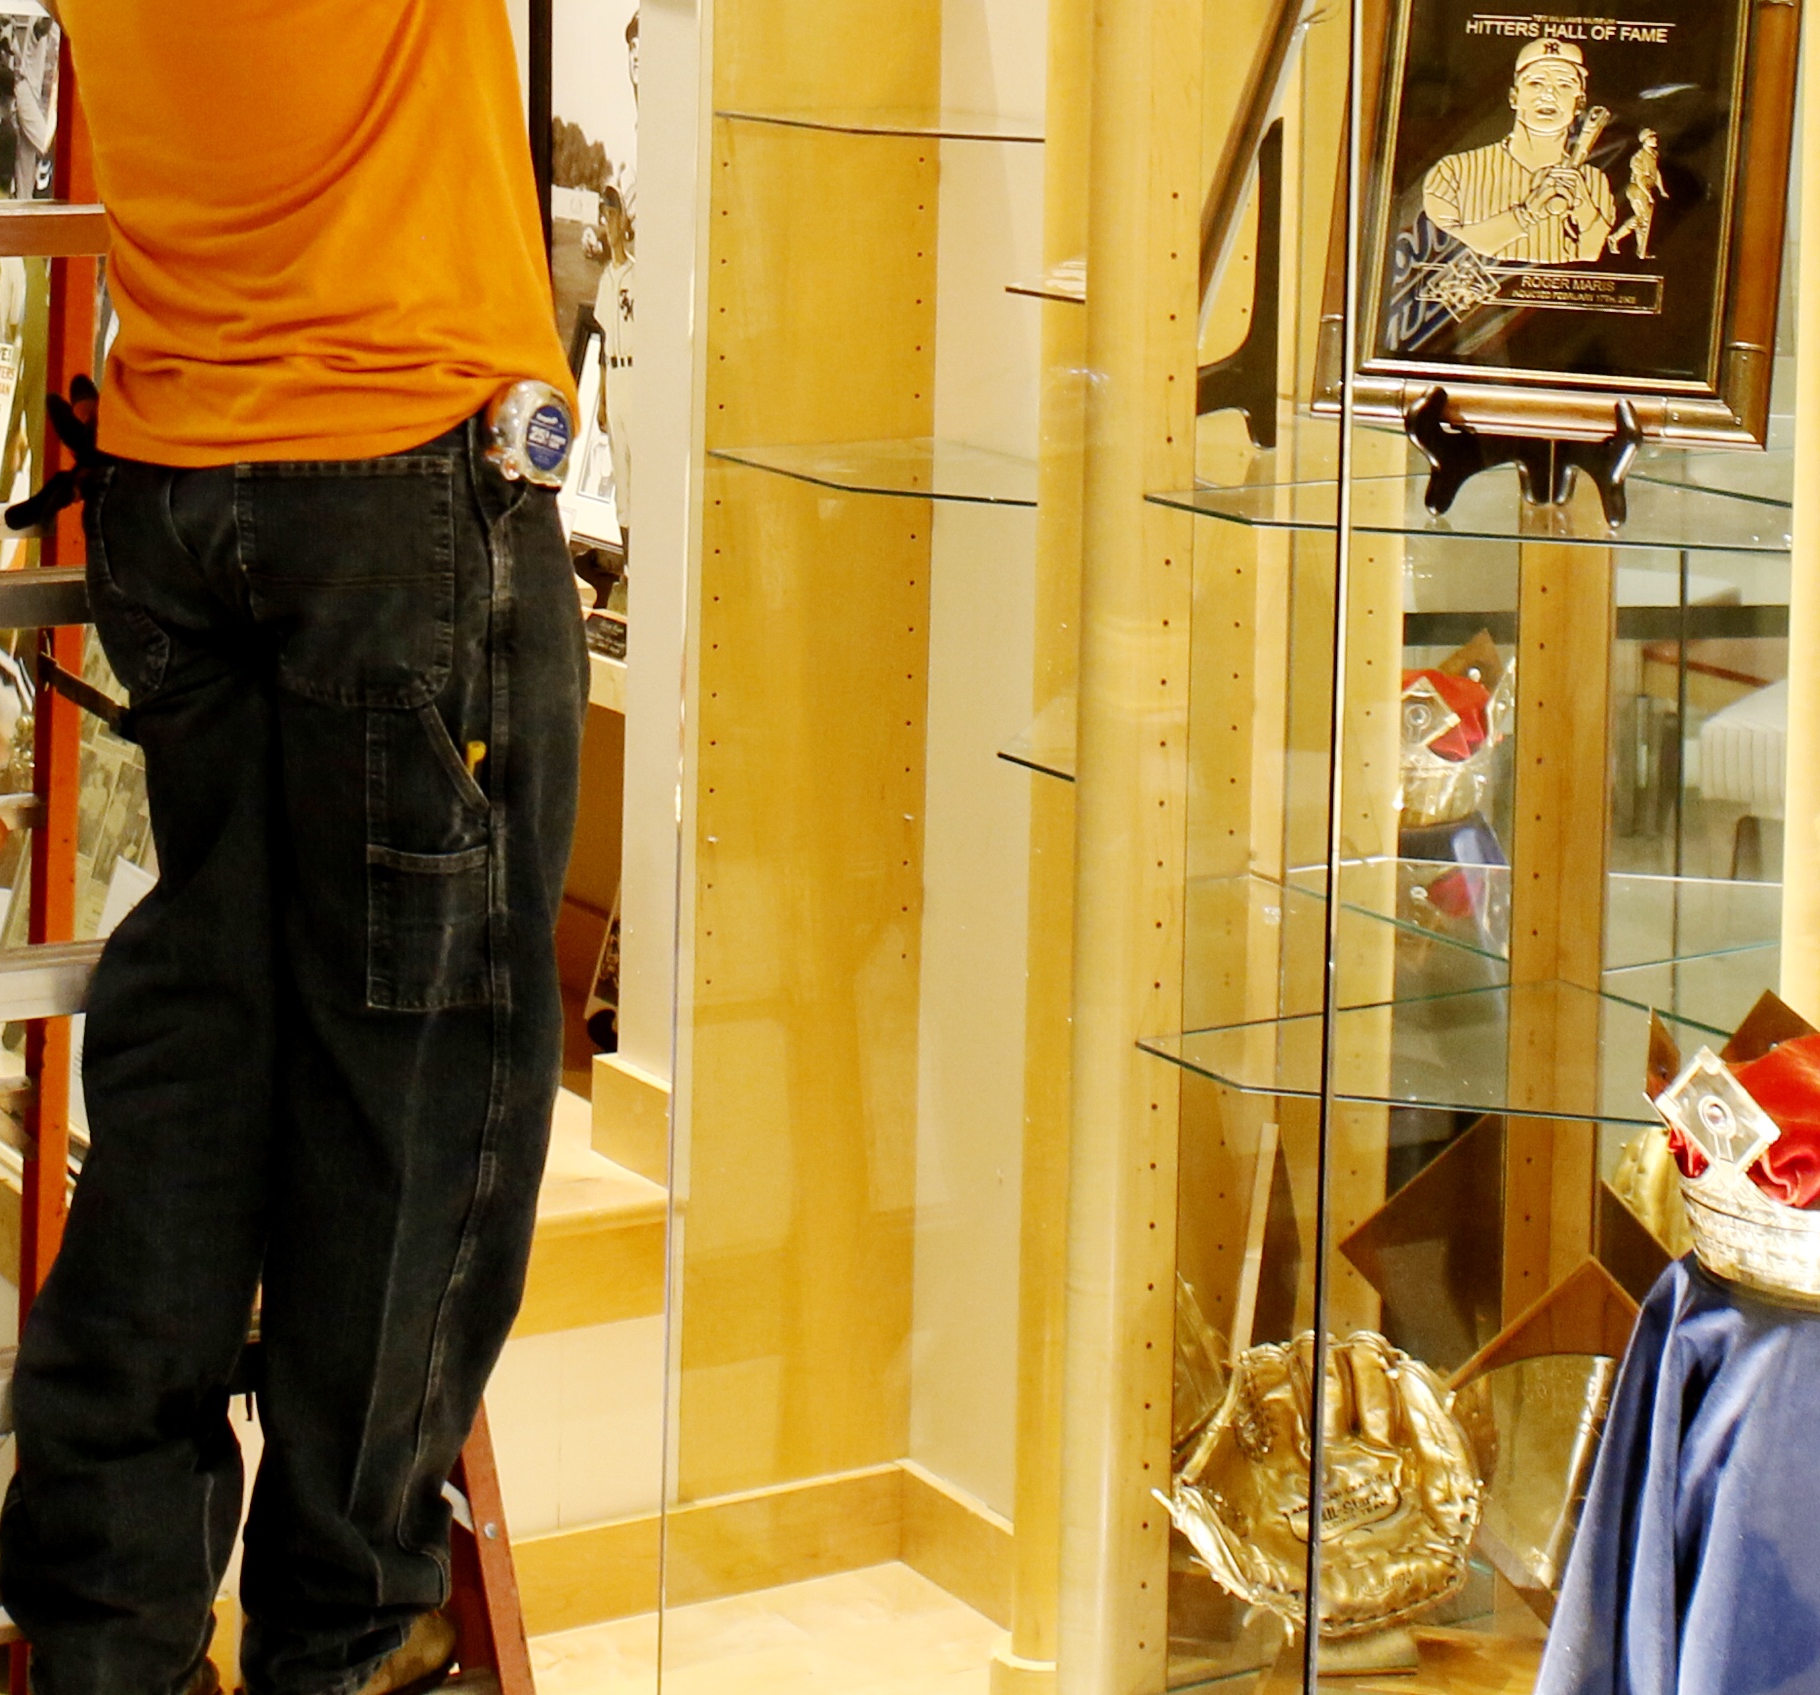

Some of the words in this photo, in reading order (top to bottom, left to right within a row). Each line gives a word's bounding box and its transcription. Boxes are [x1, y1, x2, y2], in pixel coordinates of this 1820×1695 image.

[1465, 20, 1540, 37] HITTERS
[1544, 24, 1587, 40] HALL
[1590, 25, 1617, 41] OF
[1620, 27, 1668, 43] FAME
[1521, 276, 1569, 290] ROGER
[1572, 279, 1615, 293] MARIS
